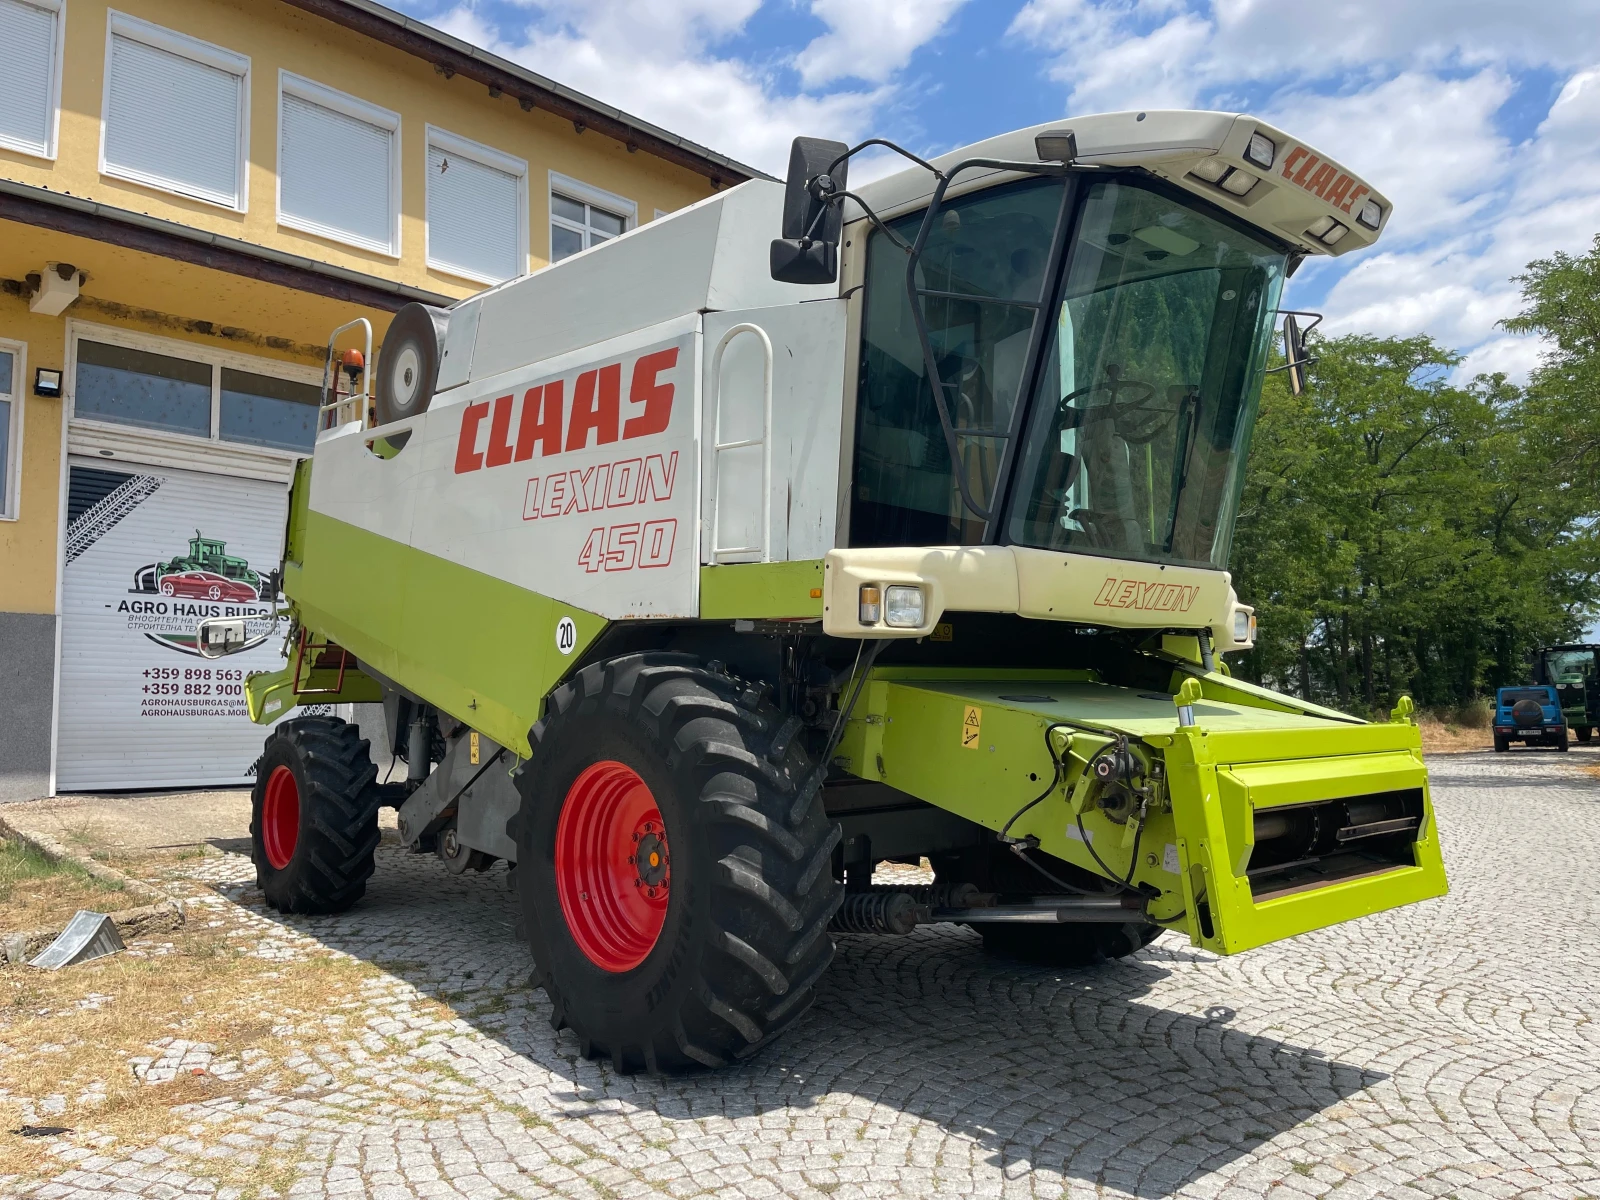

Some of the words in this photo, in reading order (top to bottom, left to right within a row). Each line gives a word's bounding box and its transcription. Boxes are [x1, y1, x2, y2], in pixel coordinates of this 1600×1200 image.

[1281, 146, 1370, 214] CLAAS
[454, 347, 680, 475] CLAAS
[522, 450, 679, 521] LEXION
[578, 518, 678, 573] 450
[117, 599, 168, 615] AGRO
[173, 603, 220, 618] HAUS
[1093, 578, 1200, 612] LEXION
[127, 614, 178, 624] ВНОСИТЕЛ
[180, 616, 193, 625] НА
[127, 622, 182, 632] СТРОИТЕЛНА
[559, 622, 573, 649] 20
[142, 667, 180, 680] +359
[184, 668, 212, 681] 898
[215, 669, 243, 681] 563
[141, 683, 180, 695] +359
[183, 683, 212, 696] 882
[215, 684, 242, 696] 900
